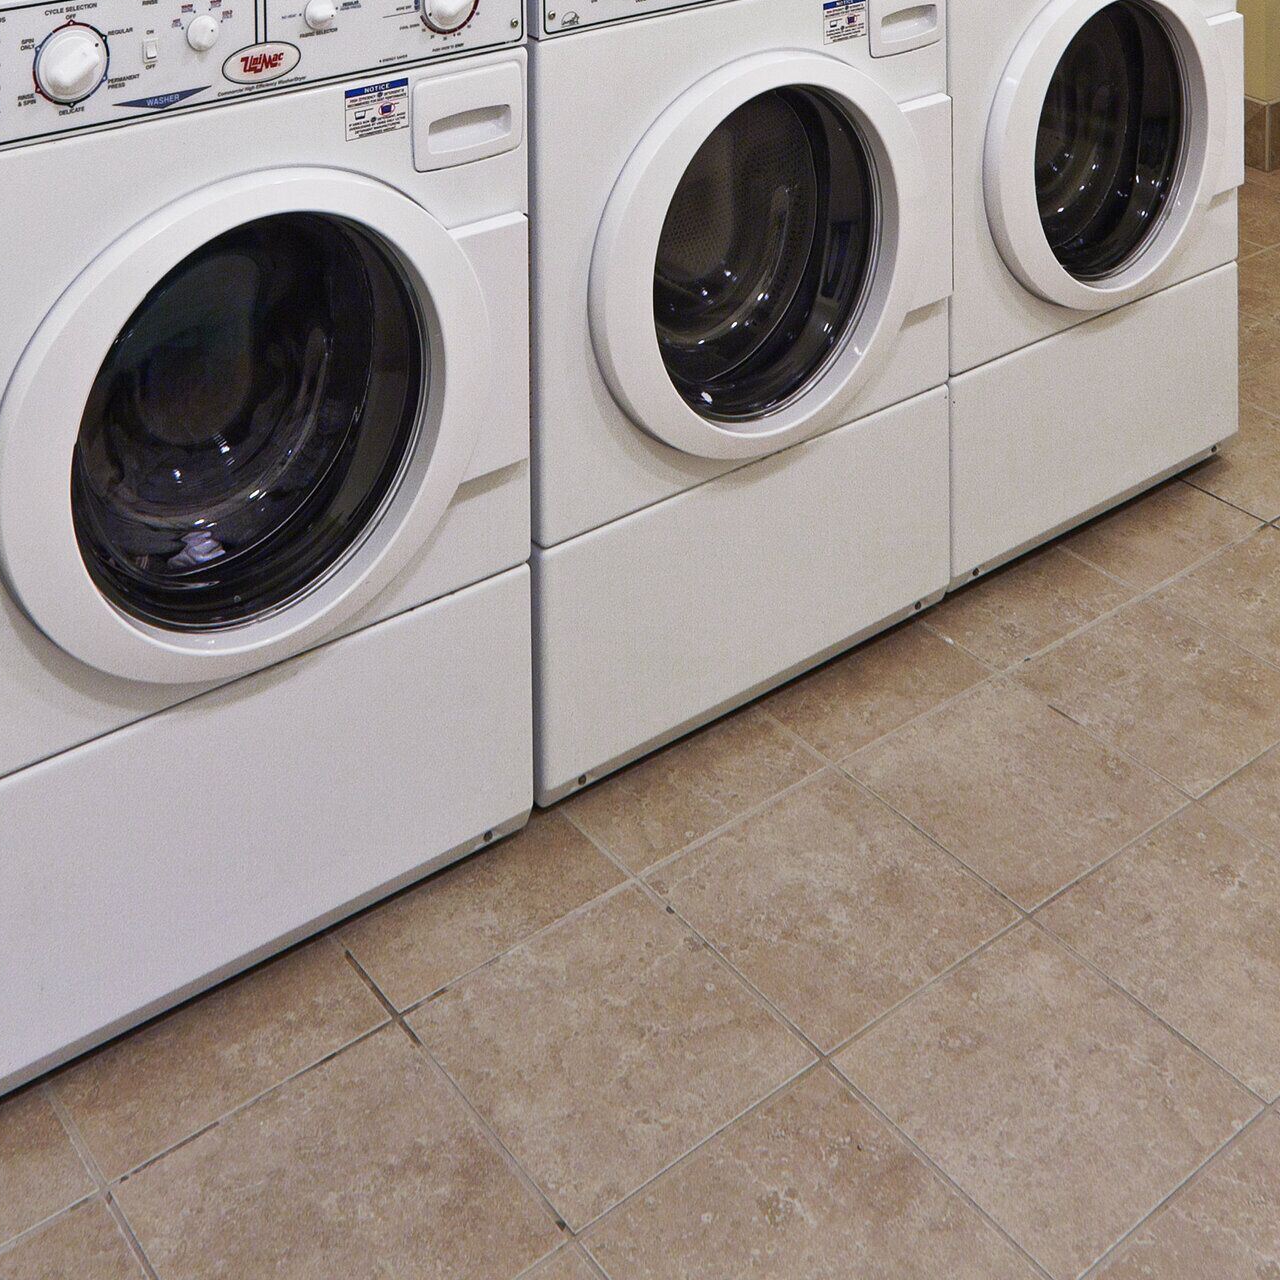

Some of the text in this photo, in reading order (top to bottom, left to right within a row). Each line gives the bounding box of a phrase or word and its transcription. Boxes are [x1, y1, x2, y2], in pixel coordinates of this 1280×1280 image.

[45, 3, 97, 16] CYCLE SELECTION
[108, 27, 133, 36] REGULAR
[241, 52, 284, 74] UniMac
[108, 74, 140, 85] PERMANENT
[364, 83, 390, 93] NOTICE
[146, 94, 180, 106] WASHER
[59, 106, 85, 116] DELICATE
